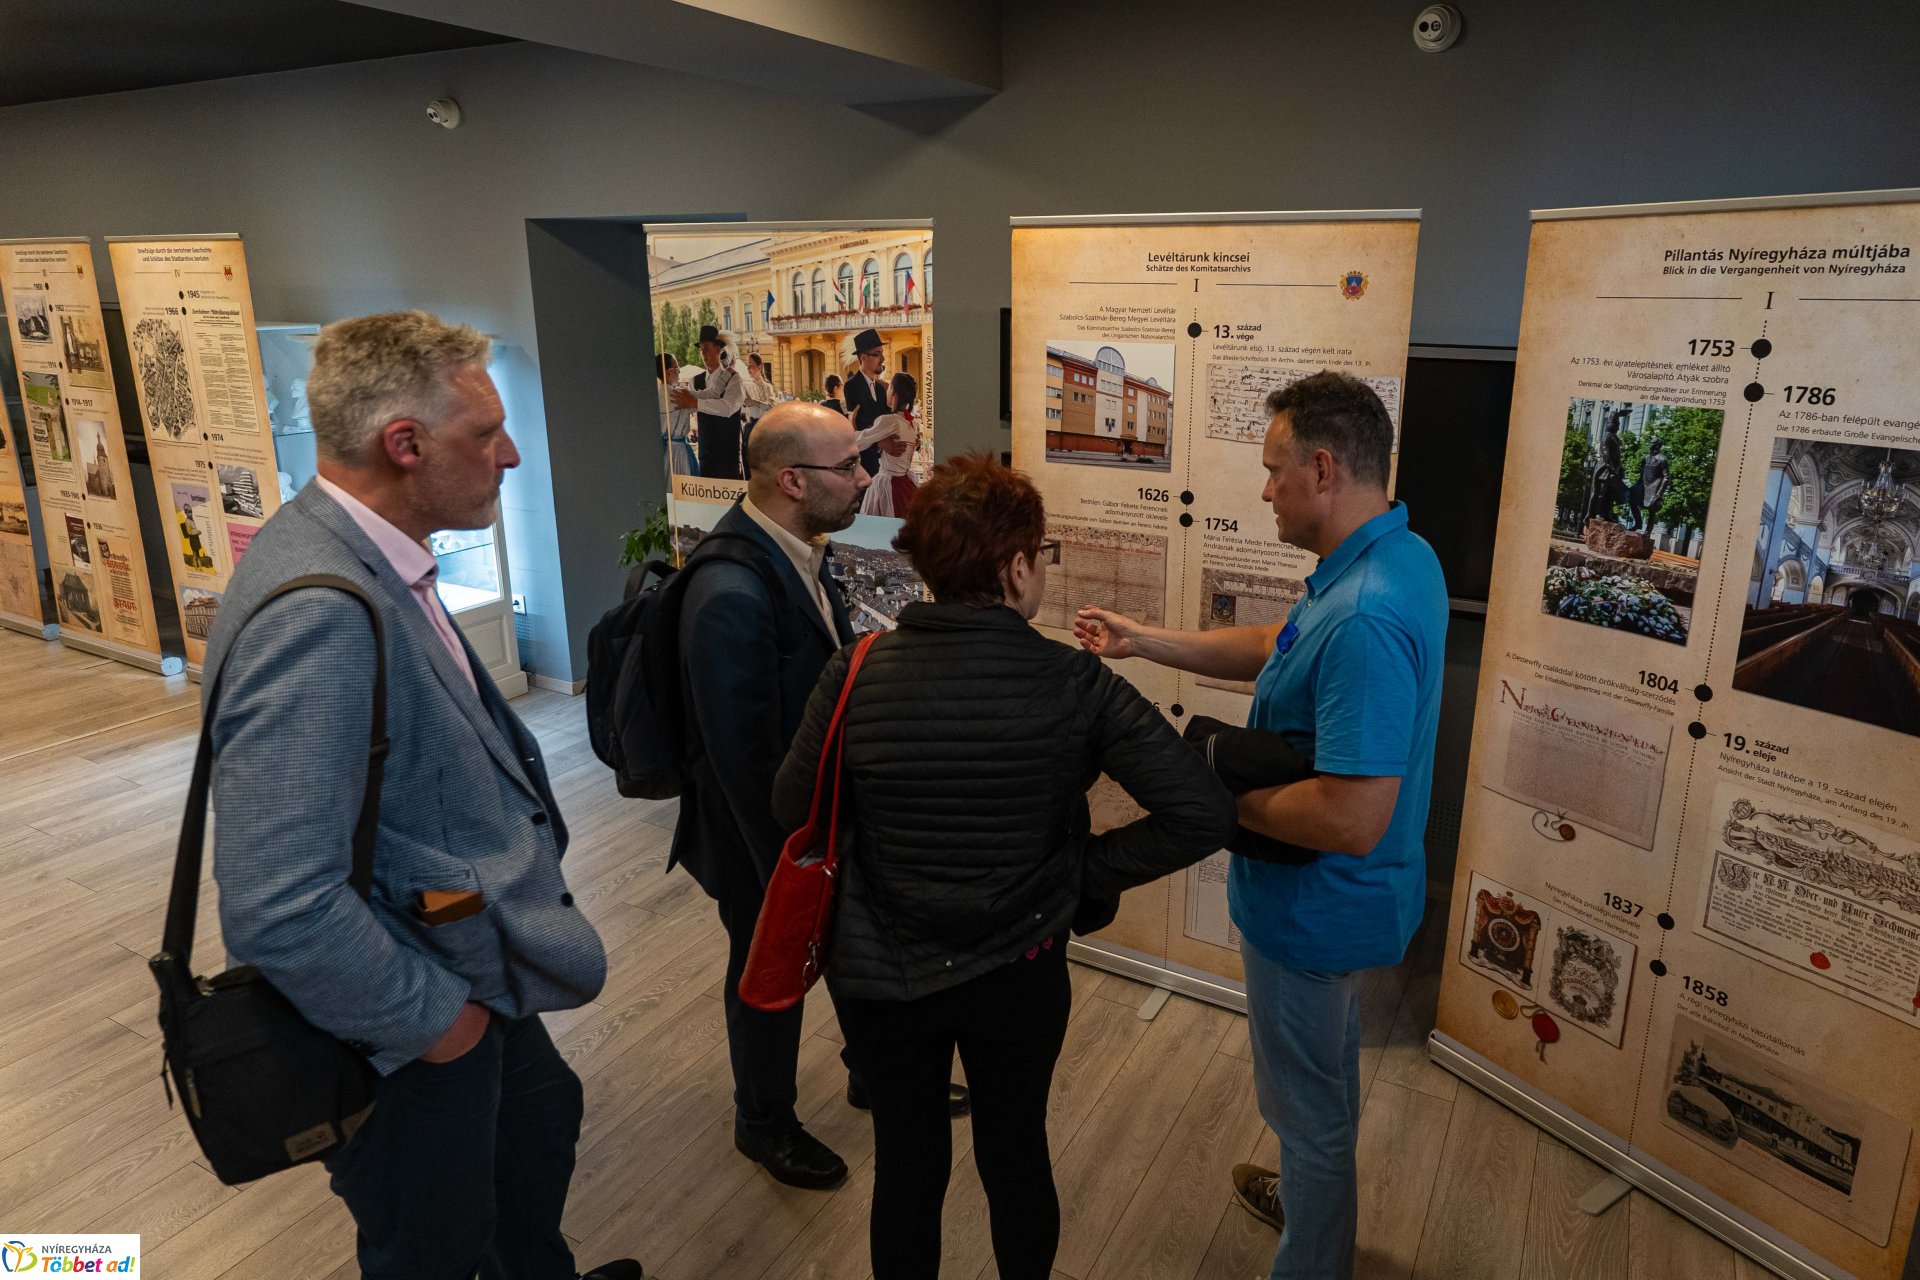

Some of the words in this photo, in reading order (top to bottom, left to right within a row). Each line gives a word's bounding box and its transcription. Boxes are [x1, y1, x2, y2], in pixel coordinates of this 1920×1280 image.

[1148, 252, 1210, 262] Levéltárunk
[1213, 252, 1250, 262] kincsei
[1664, 248, 1724, 262] Pillantás
[1728, 246, 1826, 264] Nyíregyháza
[1832, 244, 1910, 260] múltjába
[1146, 264, 1174, 272] Schätze
[1663, 266, 1684, 275] Blick
[1688, 266, 1697, 274] in
[1700, 265, 1716, 274] die
[1720, 264, 1800, 277] Vergangenheit
[1829, 264, 1906, 276] Nyíregyháza
[1193, 279, 1200, 292] I
[187, 290, 200, 298] 1945
[1764, 292, 1775, 309] I
[1106, 306, 1127, 315] Magyar
[1060, 314, 1126, 323] Szabolcs-Szatmár-Bereg
[1127, 315, 1149, 323] Megyei
[1213, 325, 1234, 339] 13.
[1237, 324, 1262, 332] század
[1213, 343, 1248, 351] Levéltárunk
[1301, 347, 1321, 355] végén
[1688, 339, 1735, 357] 1753
[1582, 358, 1601, 366] 1753.
[1615, 360, 1673, 370] újratelepítésnek
[1676, 363, 1708, 371] emléket
[1711, 364, 1731, 373] állító
[1627, 370, 1674, 382] Városalapító
[1677, 374, 1699, 384] Atyák
[1702, 375, 1728, 384] szobra
[1614, 383, 1677, 394] Stadtgründungsväter
[1692, 388, 1726, 398] Erinnerung
[1783, 385, 1836, 406] 1786
[1661, 395, 1706, 405] Neugründung
[1709, 398, 1725, 406] 1753
[1779, 410, 1790, 419] Az
[1794, 412, 1839, 422] 1786-ban
[1842, 414, 1880, 427] felépült
[1776, 424, 1789, 432] Die
[1791, 426, 1810, 434] 1786
[1812, 428, 1842, 437] erbaute
[1844, 430, 1869, 440] Große
[1138, 488, 1169, 502] 1626
[1102, 500, 1119, 508] Gábor
[1205, 518, 1238, 532] 1754
[1204, 543, 1234, 552] Andrásnak
[1236, 546, 1280, 557] adományozott
[1264, 542, 1294, 550] Ferencnek
[1542, 661, 1573, 677] családdal
[1575, 670, 1597, 683] kötött
[1534, 672, 1544, 680] Der
[1613, 692, 1622, 701] der
[1638, 670, 1679, 695] 1804
[1723, 732, 1750, 753] 19.
[1754, 738, 1789, 755] század
[1753, 749, 1776, 762] eleje
[1720, 751, 1771, 774] Nyíregyháza
[1773, 768, 1806, 785] látképe
[1808, 779, 1813, 787] a
[1817, 781, 1831, 792] 19.
[1834, 786, 1866, 802] század
[1868, 795, 1897, 812] elején
[1718, 765, 1743, 778] Ansicht
[1744, 771, 1756, 781] der
[1757, 775, 1775, 788] Stadt
[1839, 802, 1868, 817] Anfang
[1870, 809, 1883, 820] des
[1545, 881, 1584, 905] Nyíregyháza
[1604, 892, 1644, 918] 1837
[1682, 975, 1729, 1007] 1858
[1677, 1003, 1688, 1012] Der
[1688, 995, 1702, 1008] régi
[1704, 1003, 1749, 1030] nyíregyházi
